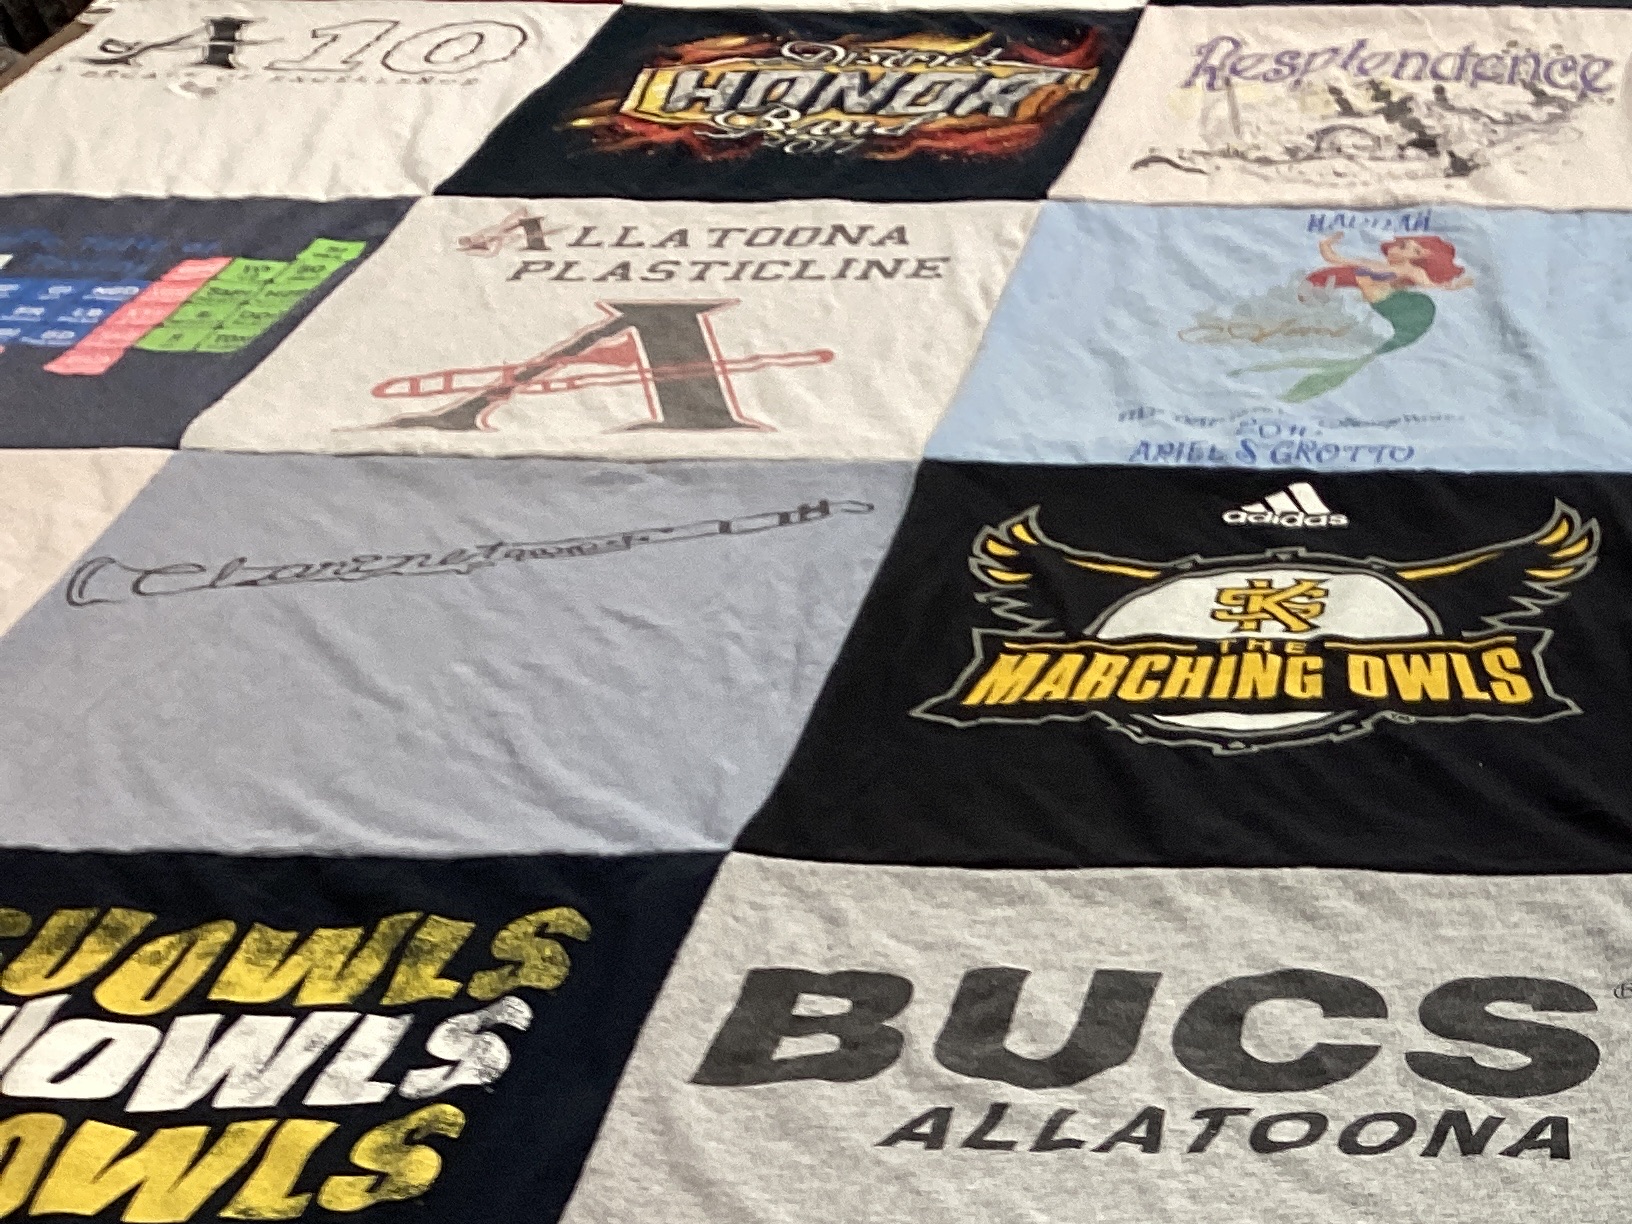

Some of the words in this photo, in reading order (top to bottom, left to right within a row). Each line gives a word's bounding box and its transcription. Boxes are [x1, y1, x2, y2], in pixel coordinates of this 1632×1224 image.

[1182, 35, 1617, 94] Resplendence
[664, 67, 1064, 118] HONOR
[457, 211, 912, 256] ALLATOONA
[505, 256, 952, 282] PLASTICLINE
[1222, 509, 1350, 528] adidas
[1218, 637, 1309, 654] THE
[962, 652, 1323, 706] MARCHING
[1348, 652, 1535, 705] OWLS
[688, 967, 1602, 1098] BUCS
[876, 1105, 1572, 1160] ALLATOONA
